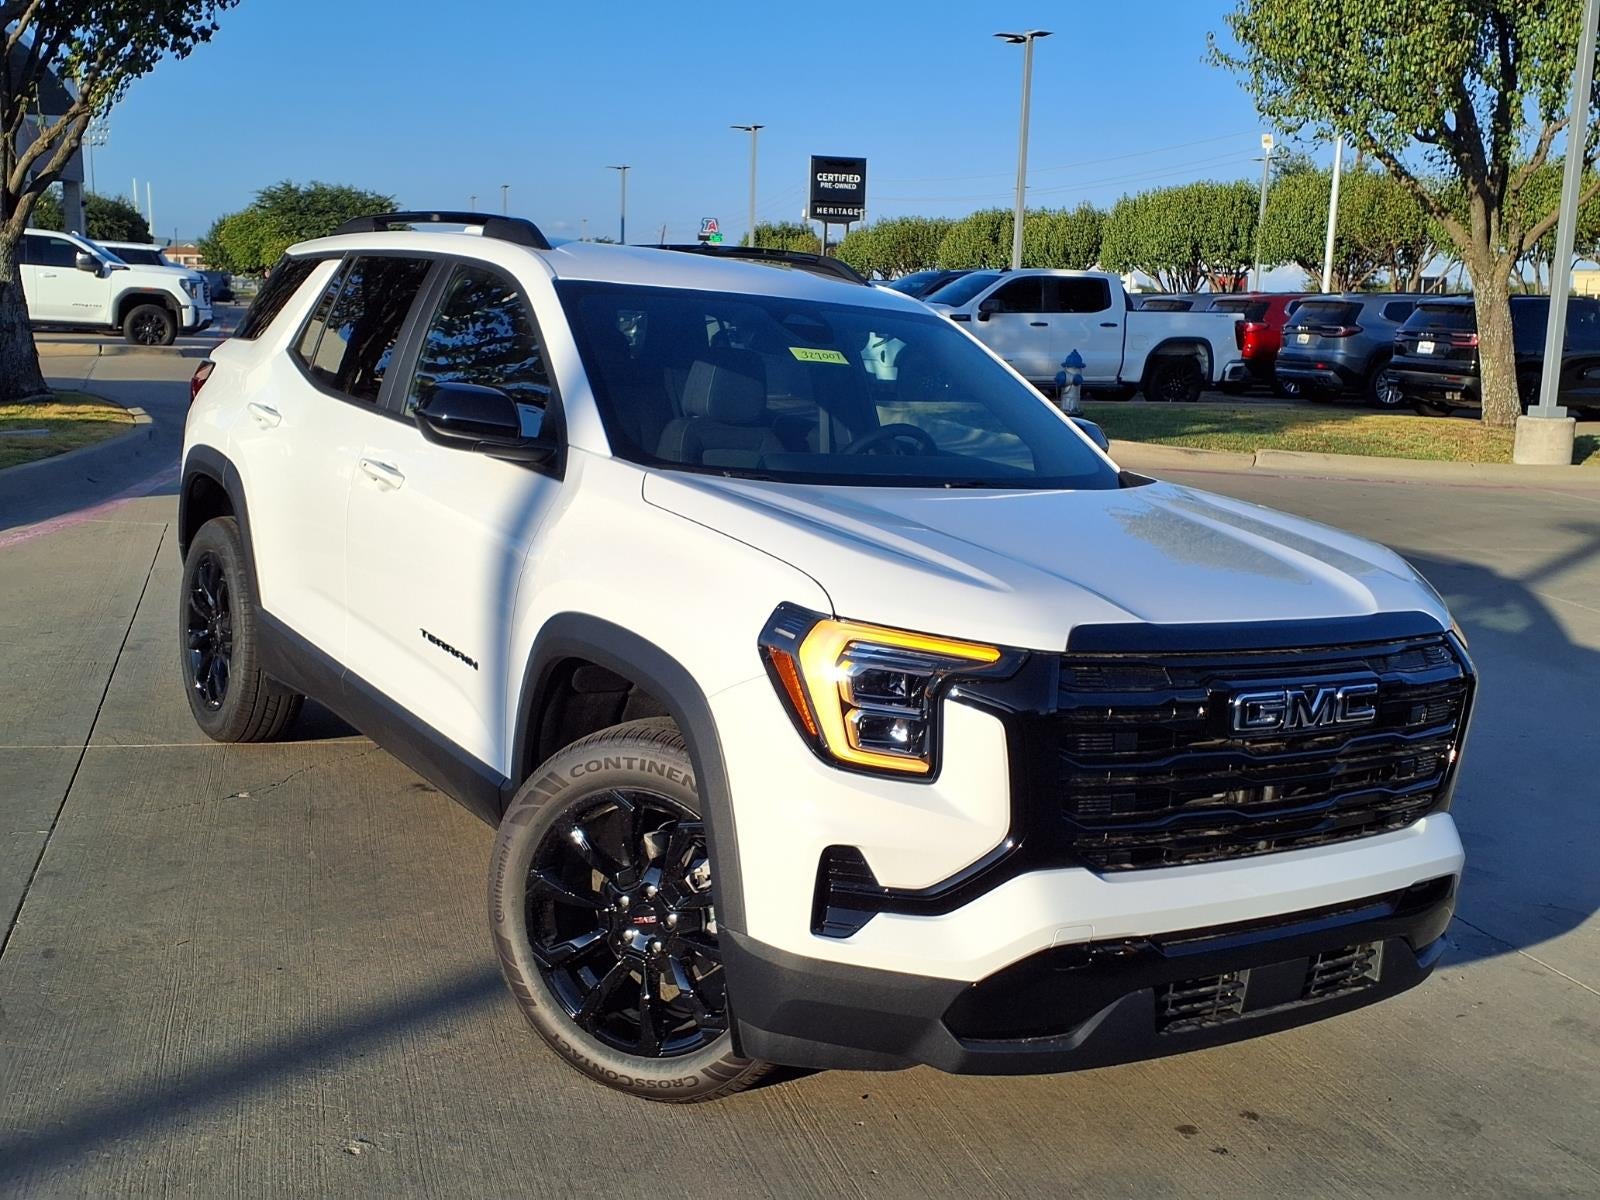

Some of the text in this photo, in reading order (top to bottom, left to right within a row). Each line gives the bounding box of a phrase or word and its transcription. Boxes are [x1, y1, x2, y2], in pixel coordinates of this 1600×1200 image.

[817, 172, 861, 183] CERTIFIED
[820, 182, 857, 190] PRE-OWNED
[816, 206, 860, 216] HERITAGE
[702, 218, 718, 233] TA
[419, 628, 479, 671] TERRAIN
[1233, 683, 1378, 732] GMC
